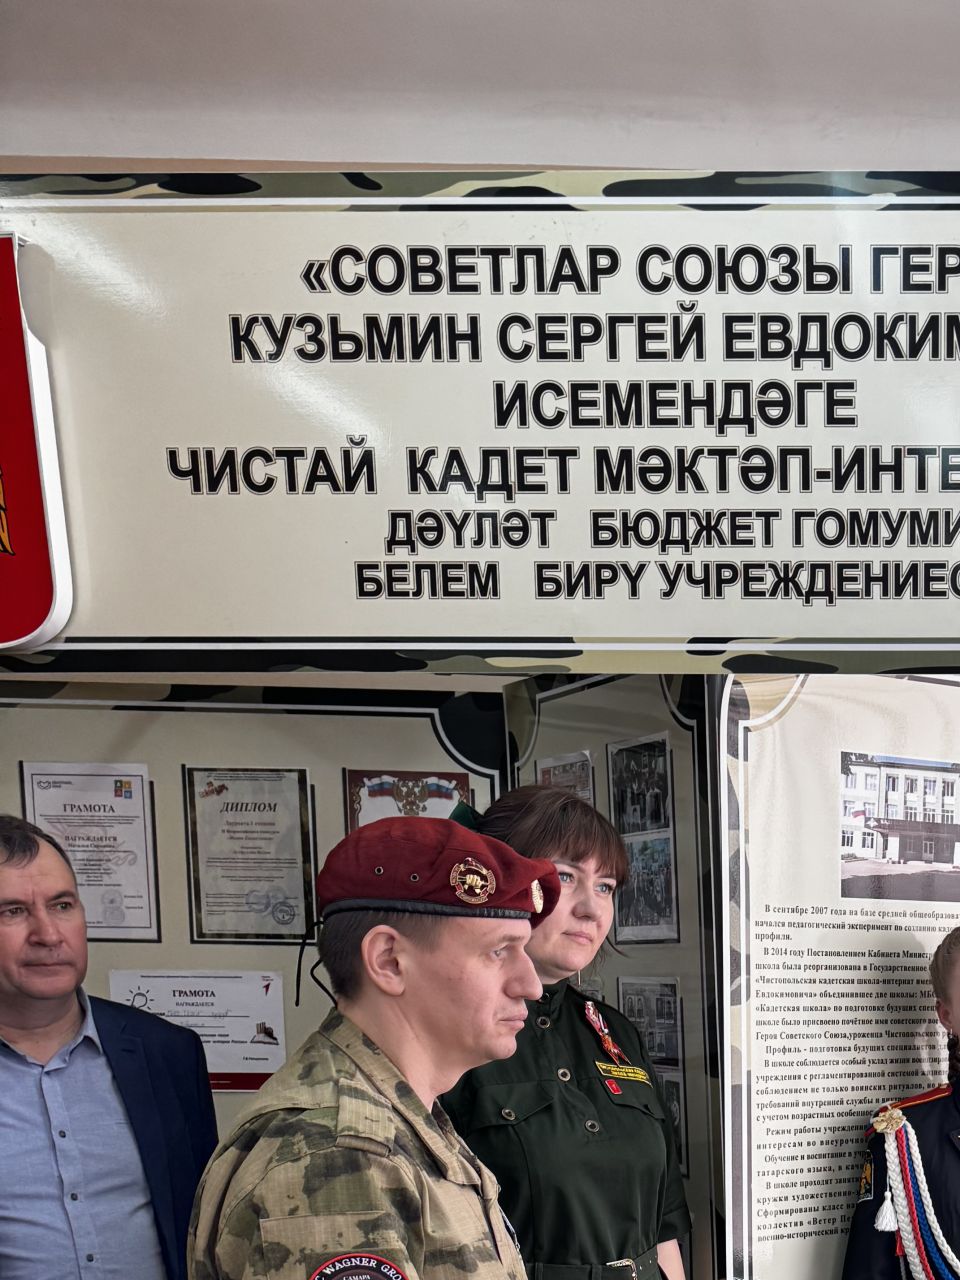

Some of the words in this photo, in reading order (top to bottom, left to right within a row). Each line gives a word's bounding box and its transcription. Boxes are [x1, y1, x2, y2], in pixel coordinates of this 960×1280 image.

[301, 245, 621, 296] «СОВЕТЛАР
[637, 243, 852, 295] СОЮЗЫ
[230, 313, 482, 362] КУЗЬМИН
[496, 300, 706, 362] СЕРГЕЙ
[492, 379, 858, 437] ИСЕМЕНДӘГЕ
[166, 434, 378, 495] ЧИСТАЙ
[407, 446, 580, 503] КАДЕТ
[384, 509, 557, 555] ДӘҮЛӘТ
[590, 508, 782, 555] БЮДЖЕТ
[355, 561, 500, 600] БЕЛЕМ
[62, 803, 116, 814] ГРАМОТА
[220, 801, 278, 813] ДИПЛОМ
[773, 905, 809, 916] сентябре
[810, 906, 828, 915] 2007
[877, 908, 908, 919] средней
[787, 920, 846, 930] педагогический
[847, 923, 892, 932] эксперимент
[771, 947, 788, 957] 2014
[806, 949, 866, 959] Постановлением
[867, 950, 901, 959] Кабинета
[755, 961, 780, 970] школа
[803, 963, 861, 973] реорганизована
[869, 963, 927, 974] Государственное
[755, 976, 817, 986] «Чистопольская
[818, 977, 855, 986] кадетская
[856, 977, 914, 987] школа-интернат
[172, 989, 217, 998] ГРАМОТА
[755, 989, 817, 999] Евдокимовича»
[819, 989, 873, 999] объединившее
[755, 1003, 801, 1013] «Кадетская
[802, 1003, 832, 1013] школа»
[844, 1004, 885, 1014] подготовке
[755, 1018, 780, 1026] школе
[781, 1017, 801, 1026] было
[802, 1018, 840, 1028] присвоено
[755, 1031, 778, 1043] Героя
[779, 1031, 822, 1041] Советского
[765, 1045, 802, 1056] Профиль
[809, 1045, 852, 1055] подготовка
[771, 1059, 795, 1068] школе
[796, 1058, 840, 1068] соблюдается
[841, 1056, 867, 1067] особый
[755, 1074, 802, 1084] учреждения
[809, 1070, 886, 1082] регламентированной
[755, 1085, 808, 1096] соблюдением
[822, 1085, 849, 1094] только
[850, 1083, 886, 1093] воинских
[755, 1099, 800, 1110] требований
[801, 1097, 845, 1109] внутренней
[762, 1113, 790, 1123] учетом
[791, 1111, 835, 1122] возрастных
[765, 1126, 792, 1137] Режим
[793, 1124, 822, 1136] работы
[756, 1140, 803, 1151] интересам
[764, 1153, 799, 1164] Обучение
[806, 1150, 847, 1161] воспитание
[756, 1167, 804, 1178] татарского
[773, 1180, 798, 1189] школе
[799, 1177, 833, 1189] проходят
[756, 1195, 789, 1207] кружки
[756, 1205, 820, 1219] Сформированы
[757, 1219, 804, 1232] коллектив
[806, 1215, 837, 1228] «Ветер
[757, 1226, 839, 1243] военно-исторический
[321, 1257, 378, 1276] WAGNER
